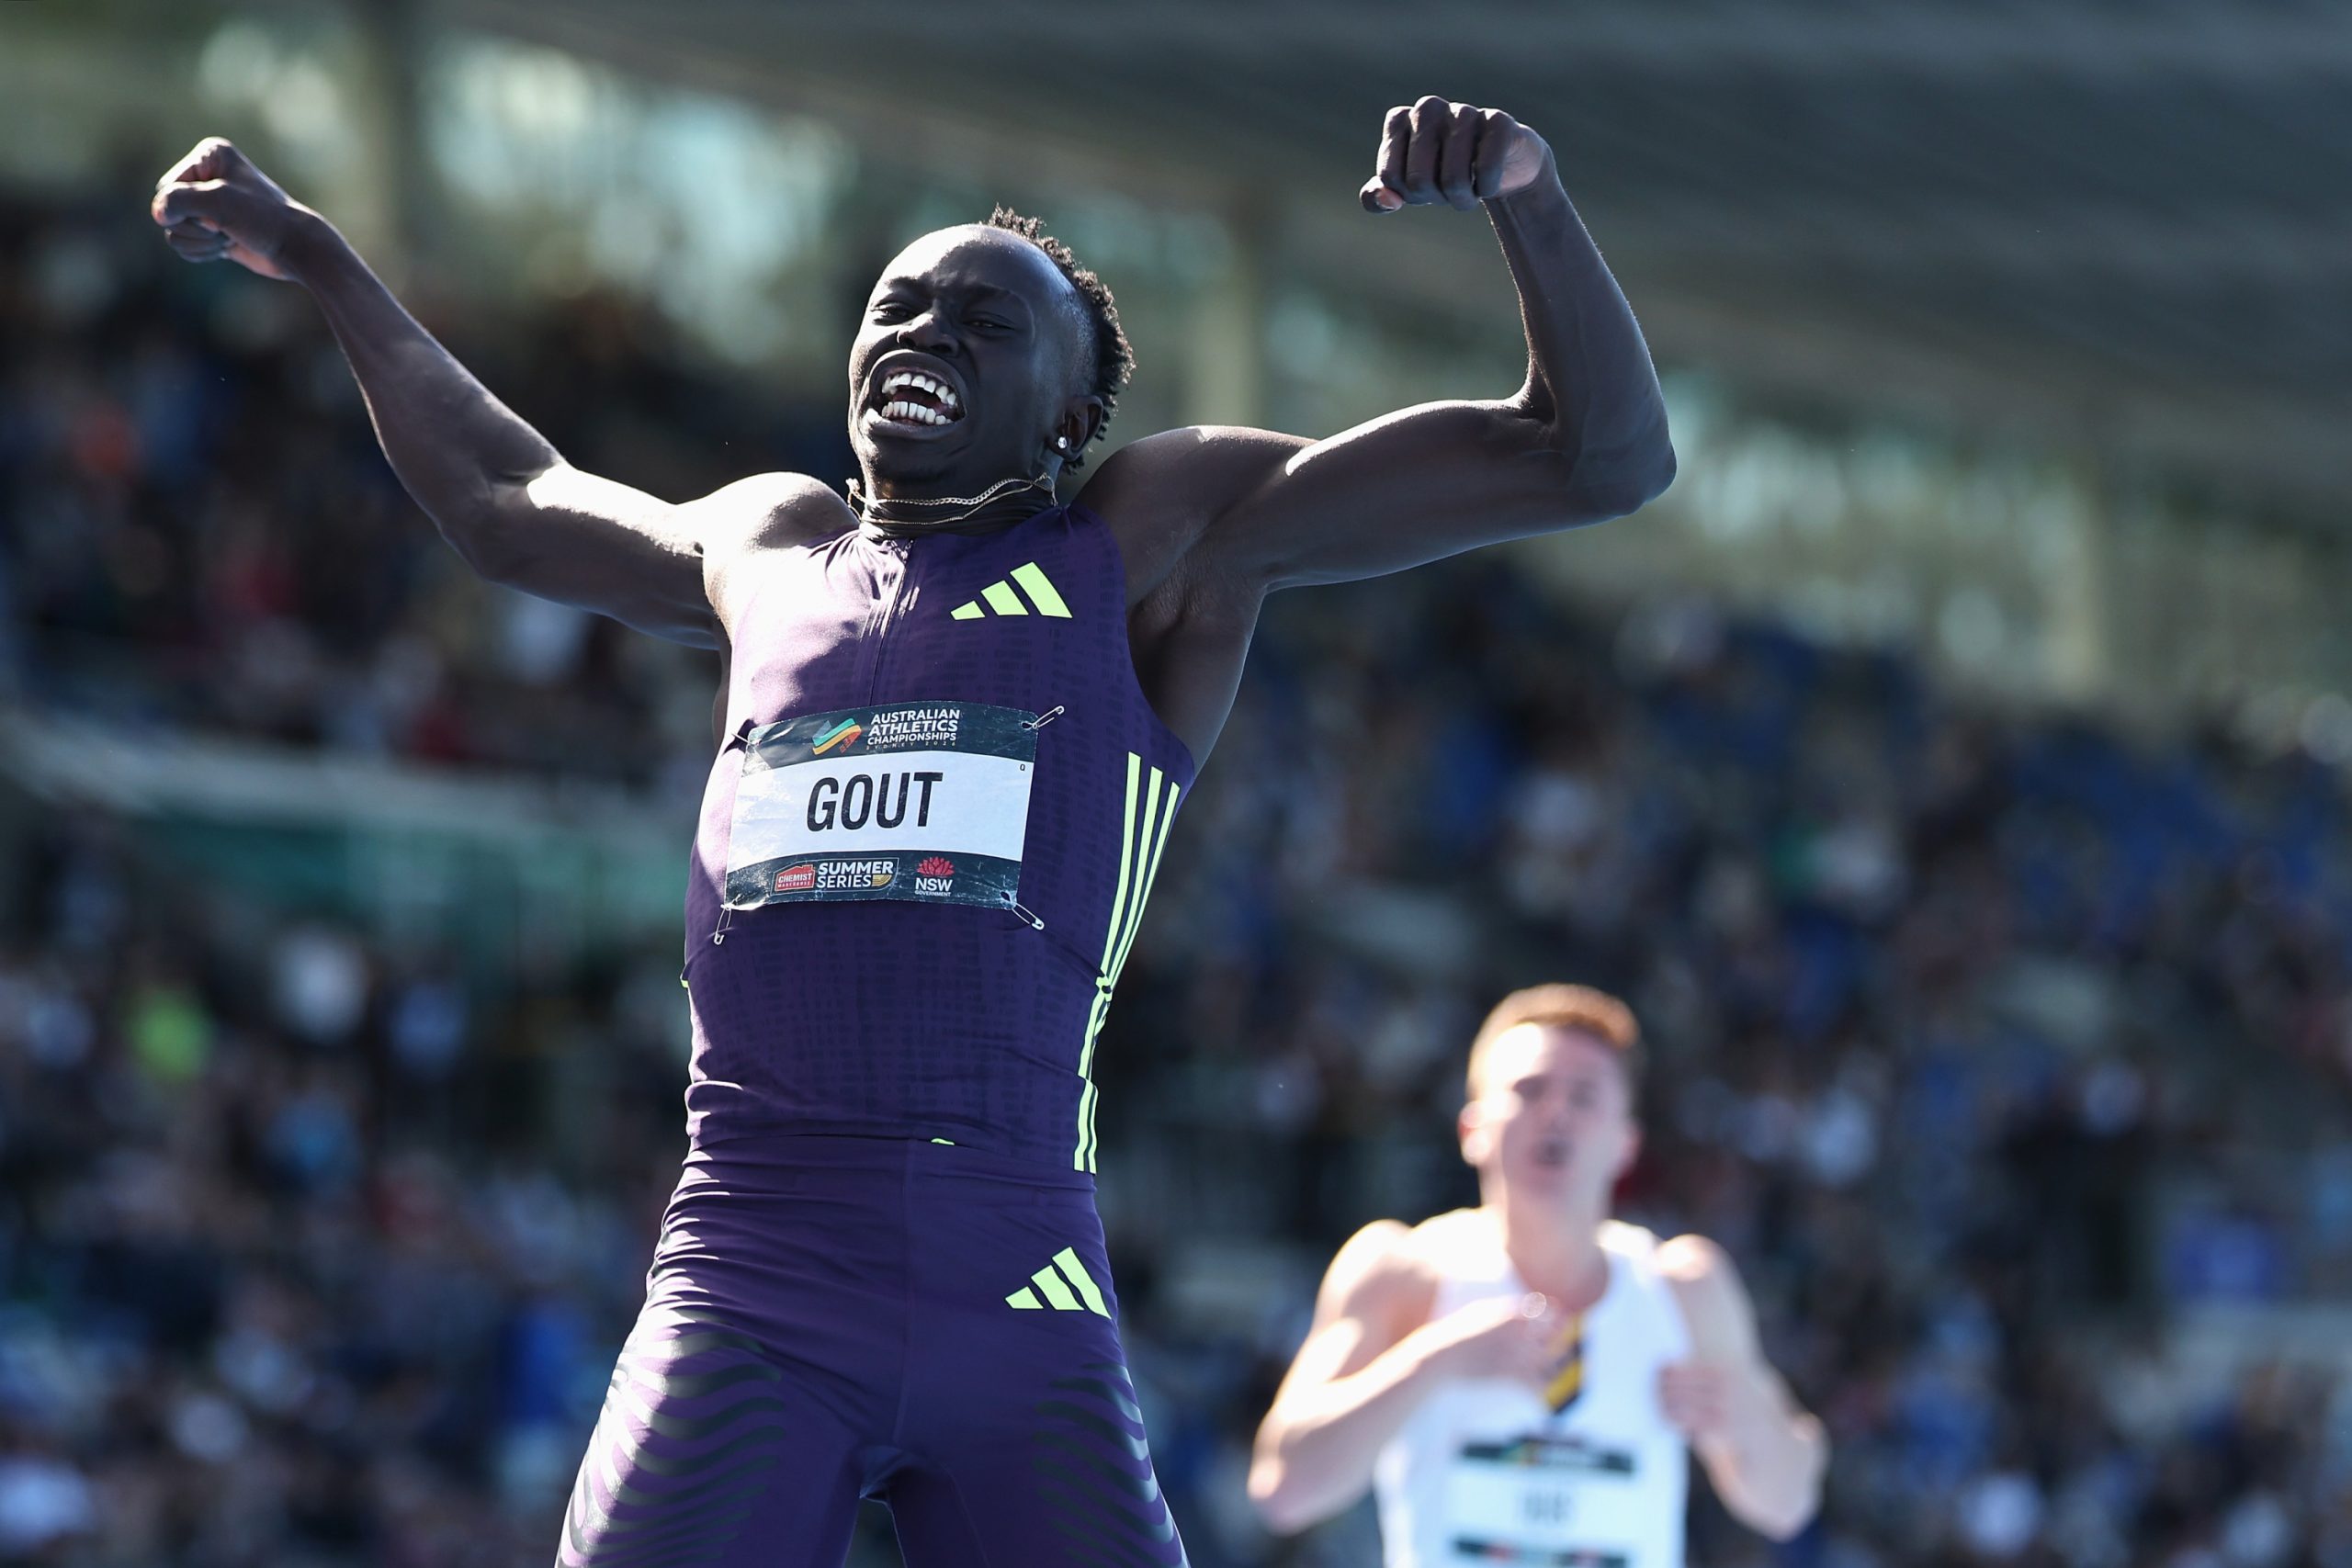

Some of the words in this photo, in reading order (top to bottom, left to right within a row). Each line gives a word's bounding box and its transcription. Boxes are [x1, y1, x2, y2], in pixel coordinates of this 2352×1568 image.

[871, 709, 960, 725] AUSTRALIAN
[868, 720, 959, 737] ATHLETICS
[867, 732, 956, 745] CHAMPIONSHIPS
[807, 772, 944, 832] GOUT
[818, 861, 894, 875] SUMMER
[778, 873, 812, 884] CHEMIST
[817, 874, 872, 888] SERIES
[915, 877, 953, 891] NSW
